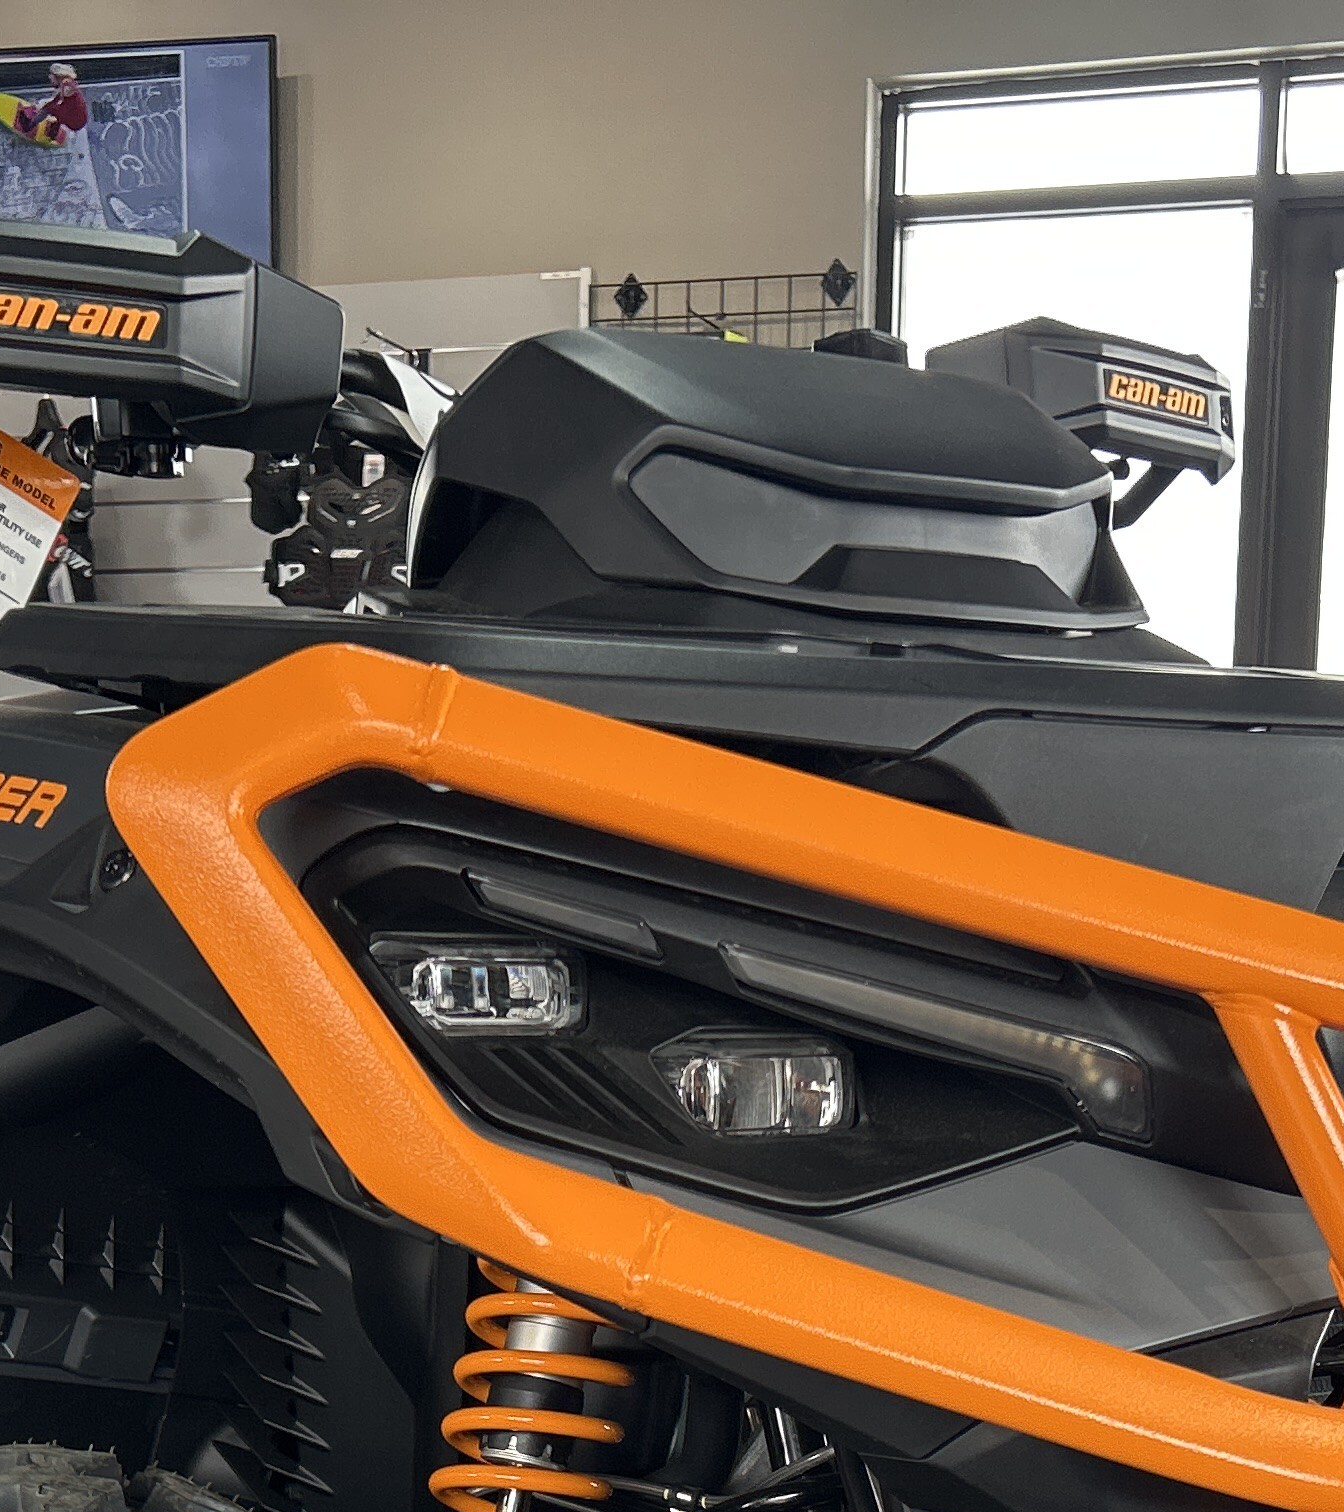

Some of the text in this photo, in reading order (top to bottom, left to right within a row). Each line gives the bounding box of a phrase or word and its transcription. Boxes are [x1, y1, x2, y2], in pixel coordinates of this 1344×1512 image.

[1108, 373, 1206, 418] can-am
[10, 474, 59, 510] MODEL
[22, 530, 43, 548] USE
